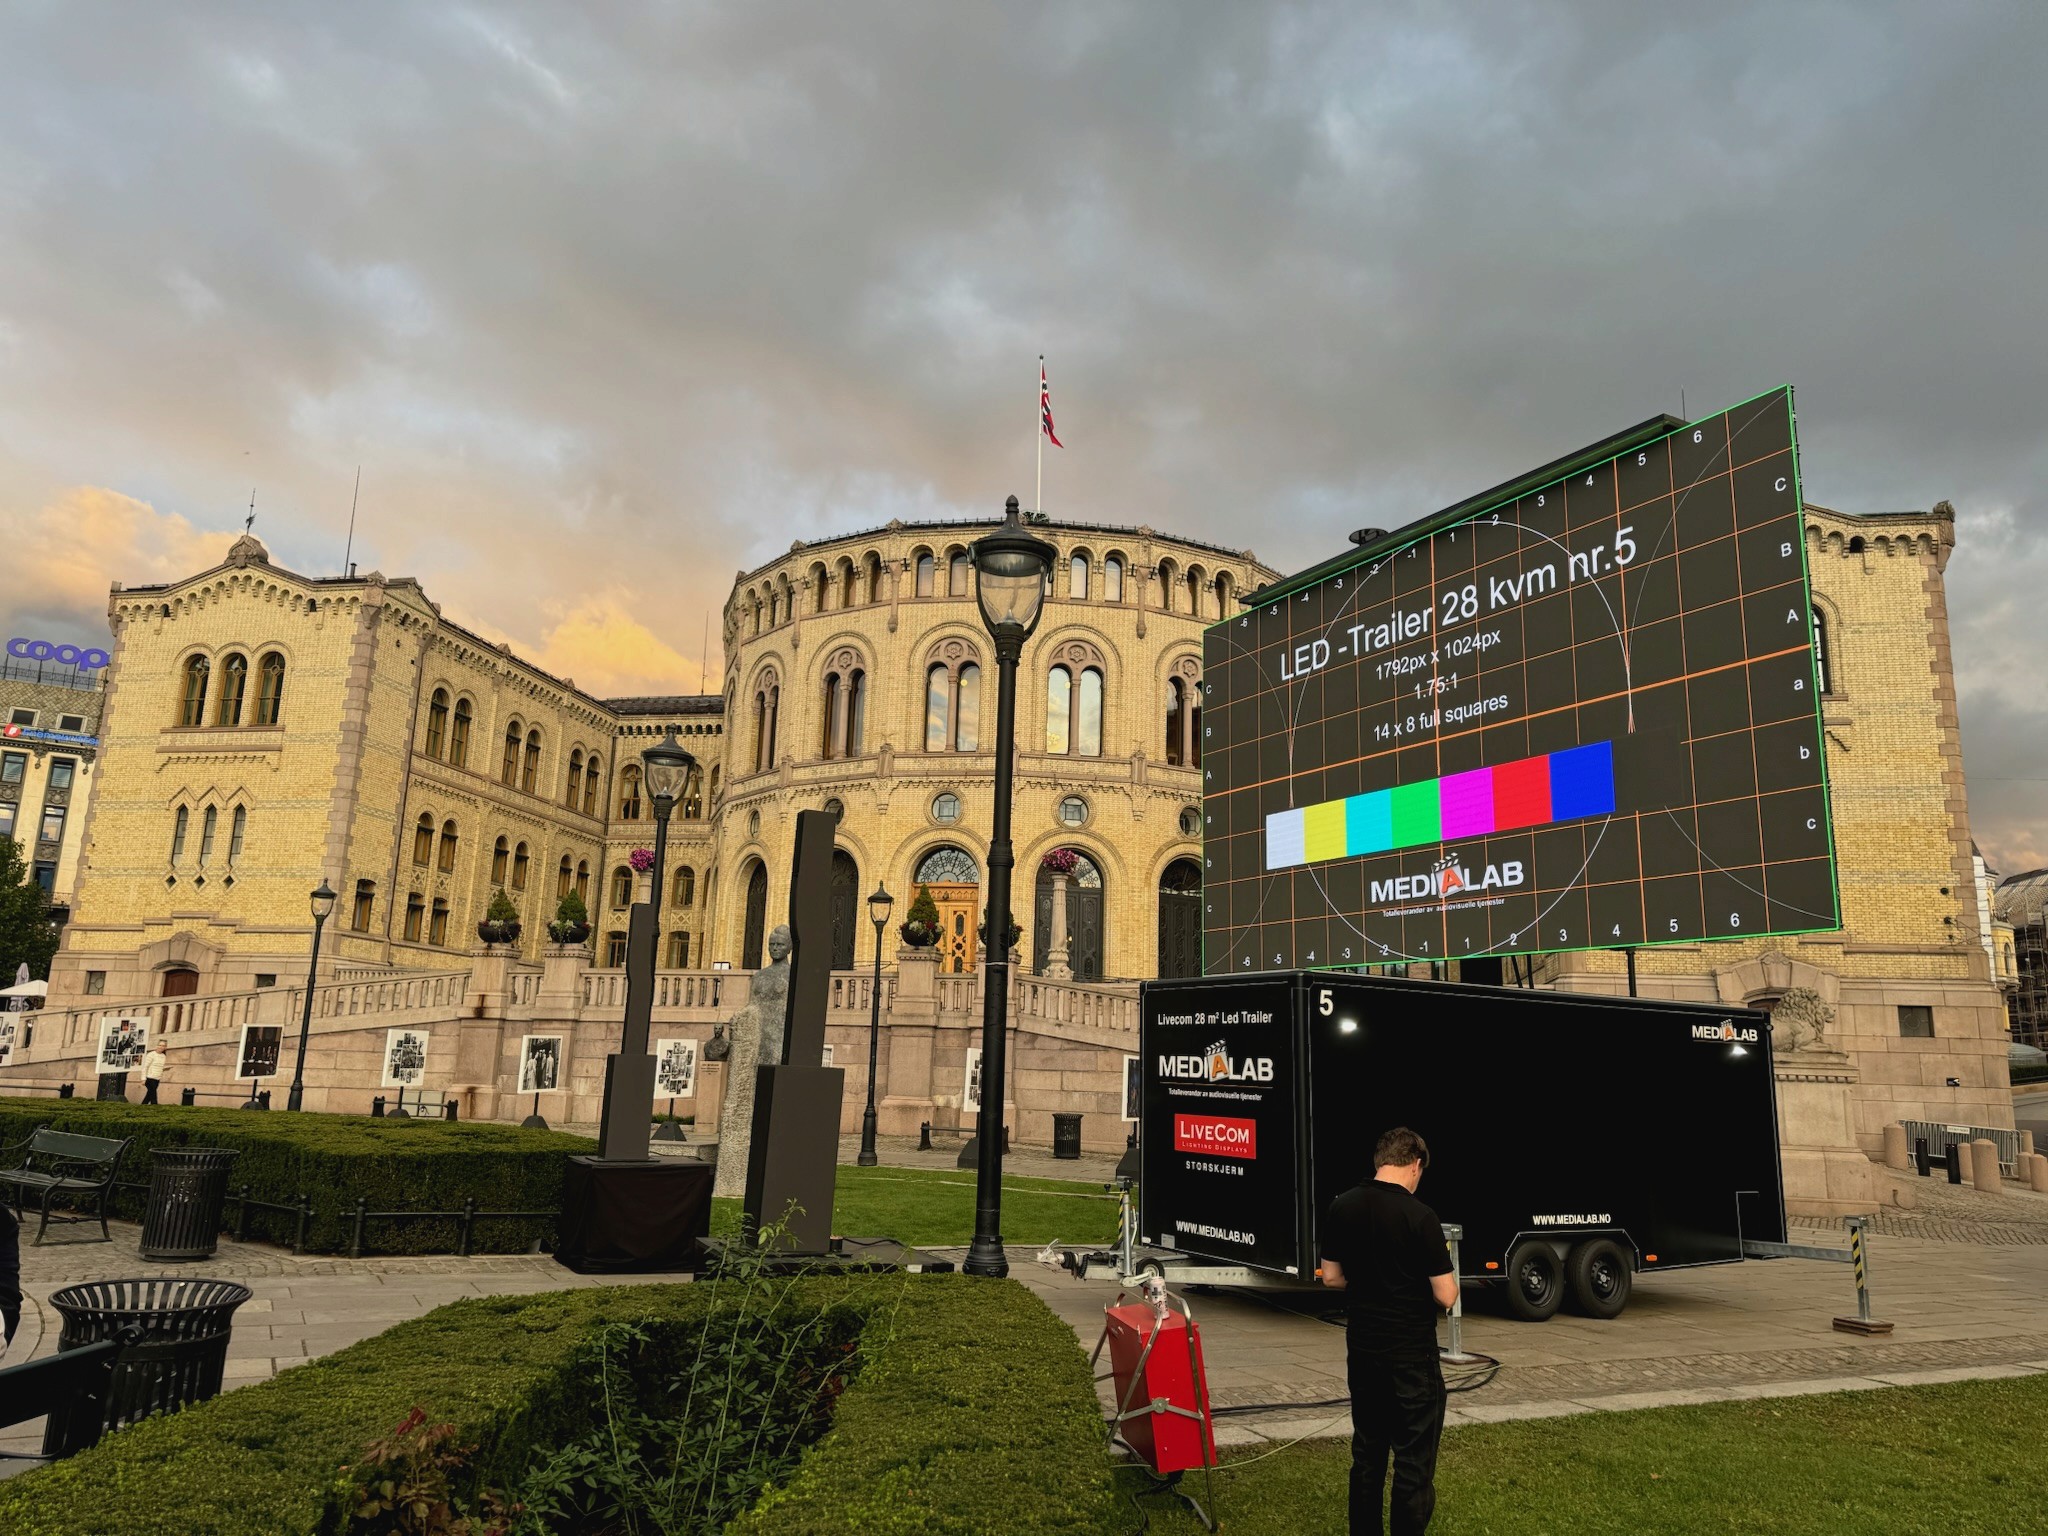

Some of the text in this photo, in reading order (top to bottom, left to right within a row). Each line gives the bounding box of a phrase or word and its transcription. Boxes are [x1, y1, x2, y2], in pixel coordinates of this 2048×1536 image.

[1774, 478, 1787, 492] C
[1240, 430, 1702, 627] -6 -5 -4 -3 -2 -1 1 2 3 4 5 6
[1780, 542, 1793, 558] B
[1280, 526, 1637, 682] LED -Trailer 28 kvm nr.5
[1786, 608, 1800, 624] A
[7, 638, 110, 672] coop
[1375, 630, 1501, 680] 1792px x 1024px
[1206, 684, 1212, 694] C
[1414, 672, 1458, 700] 1.75:1
[1793, 678, 1804, 691] a
[1374, 694, 1508, 742] 14 x 8 full squares
[1206, 728, 1212, 737] B
[1800, 745, 1810, 760] b
[1206, 770, 1212, 780] A
[1806, 817, 1817, 830] c
[1206, 858, 1212, 868] b
[1370, 861, 1524, 903] MEDIALAB
[1206, 904, 1212, 912] c
[1242, 913, 1740, 966] -6 -5 -4 -3 -2 -1 1 2 3 4 5 6
[1319, 990, 1334, 1016] 5
[1158, 1014, 1192, 1026] Livecom
[1195, 1012, 1206, 1024] 28
[1222, 1012, 1239, 1024] Led
[1241, 1011, 1272, 1024] Trailer
[1692, 1025, 1758, 1042] MEDIALAB
[1158, 1054, 1274, 1081] MEDIALAB
[1186, 1160, 1244, 1176] STORSKJERM
[1533, 1214, 1612, 1226] WWW.MEDIALAB.NO
[1176, 1220, 1255, 1245] WWW.MEDIALAB.NO
